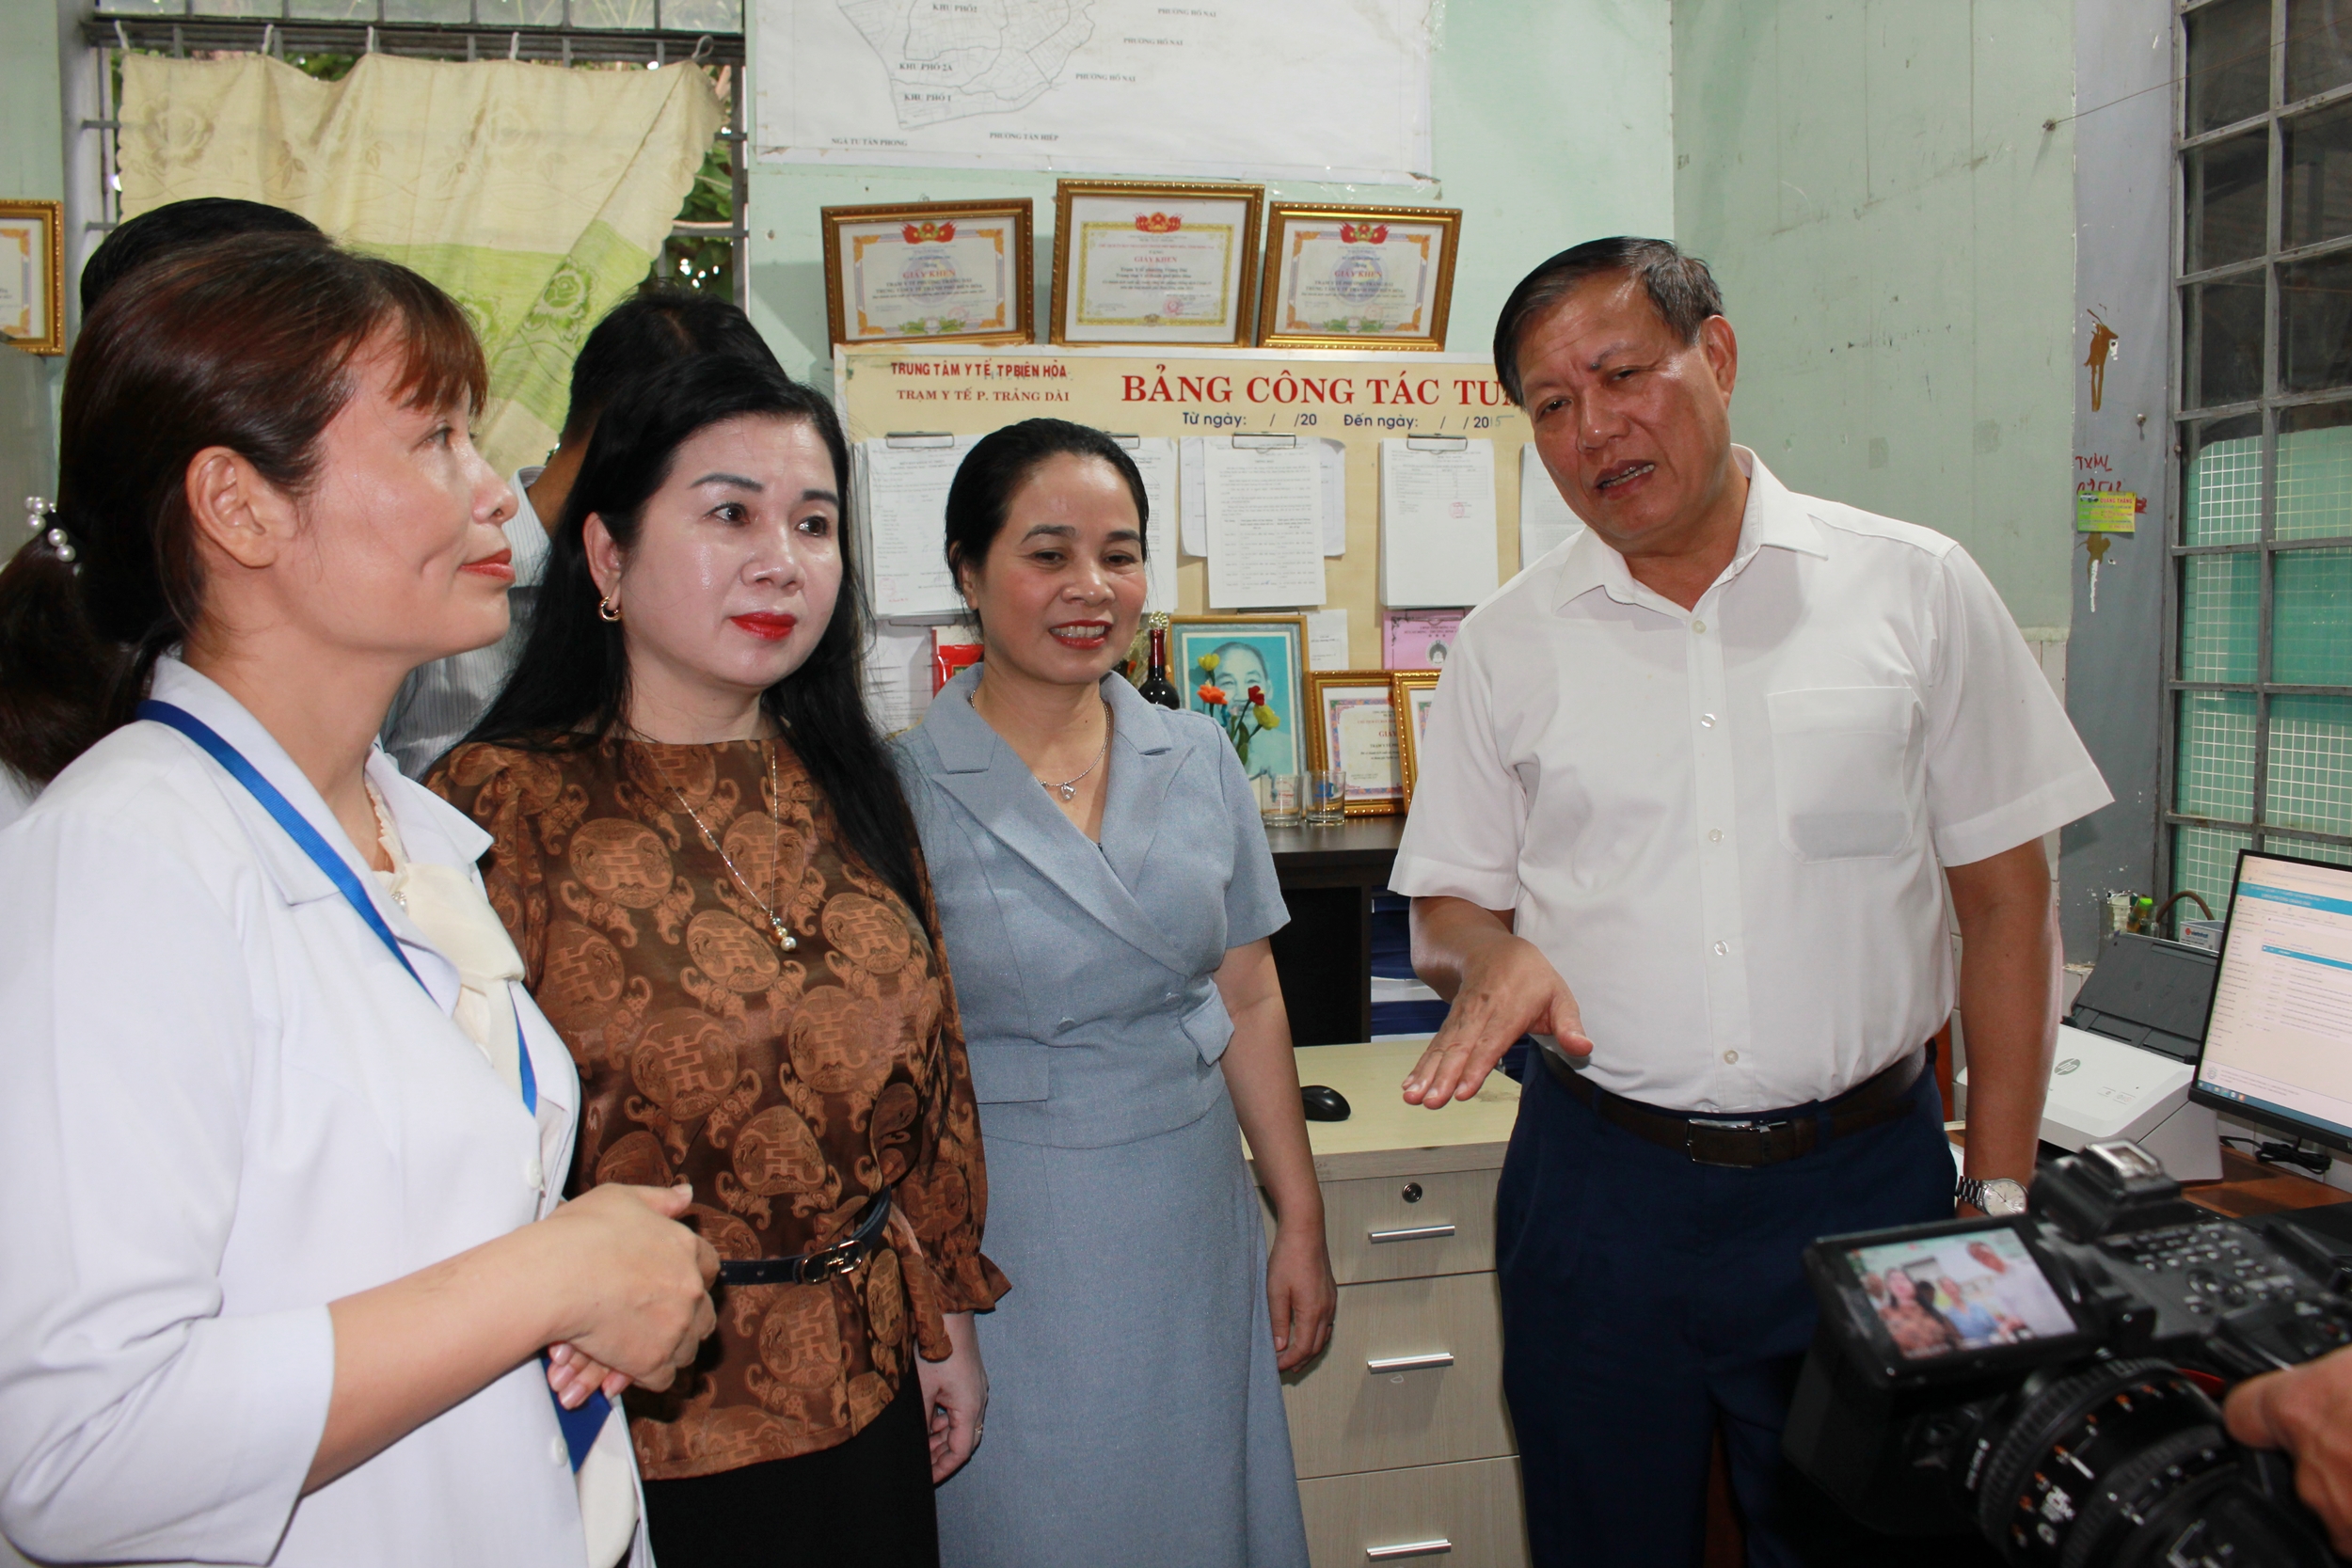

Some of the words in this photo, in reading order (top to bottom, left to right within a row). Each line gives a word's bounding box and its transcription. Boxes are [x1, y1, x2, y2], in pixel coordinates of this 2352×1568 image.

[891, 362, 930, 375] TRUNG
[933, 360, 960, 376] TÂM
[964, 363, 972, 376] Y
[1043, 359, 1067, 377] HÒA
[1120, 364, 1232, 403] BẢNG
[1247, 370, 1355, 404] CÔNG
[1366, 371, 1439, 404] TÁC
[897, 389, 937, 403] TRẠM
[941, 390, 950, 400] Y
[954, 387, 973, 401] TẾ
[977, 391, 989, 401] P.
[993, 388, 1041, 402] TRẢNG
[1044, 389, 1070, 402] DÀI
[1183, 412, 1200, 425] Từ
[1203, 412, 1247, 428] ngày:
[1343, 412, 1373, 426] Đến
[1377, 414, 1419, 429] ngày:
[2054, 1058, 2080, 1075] hp
